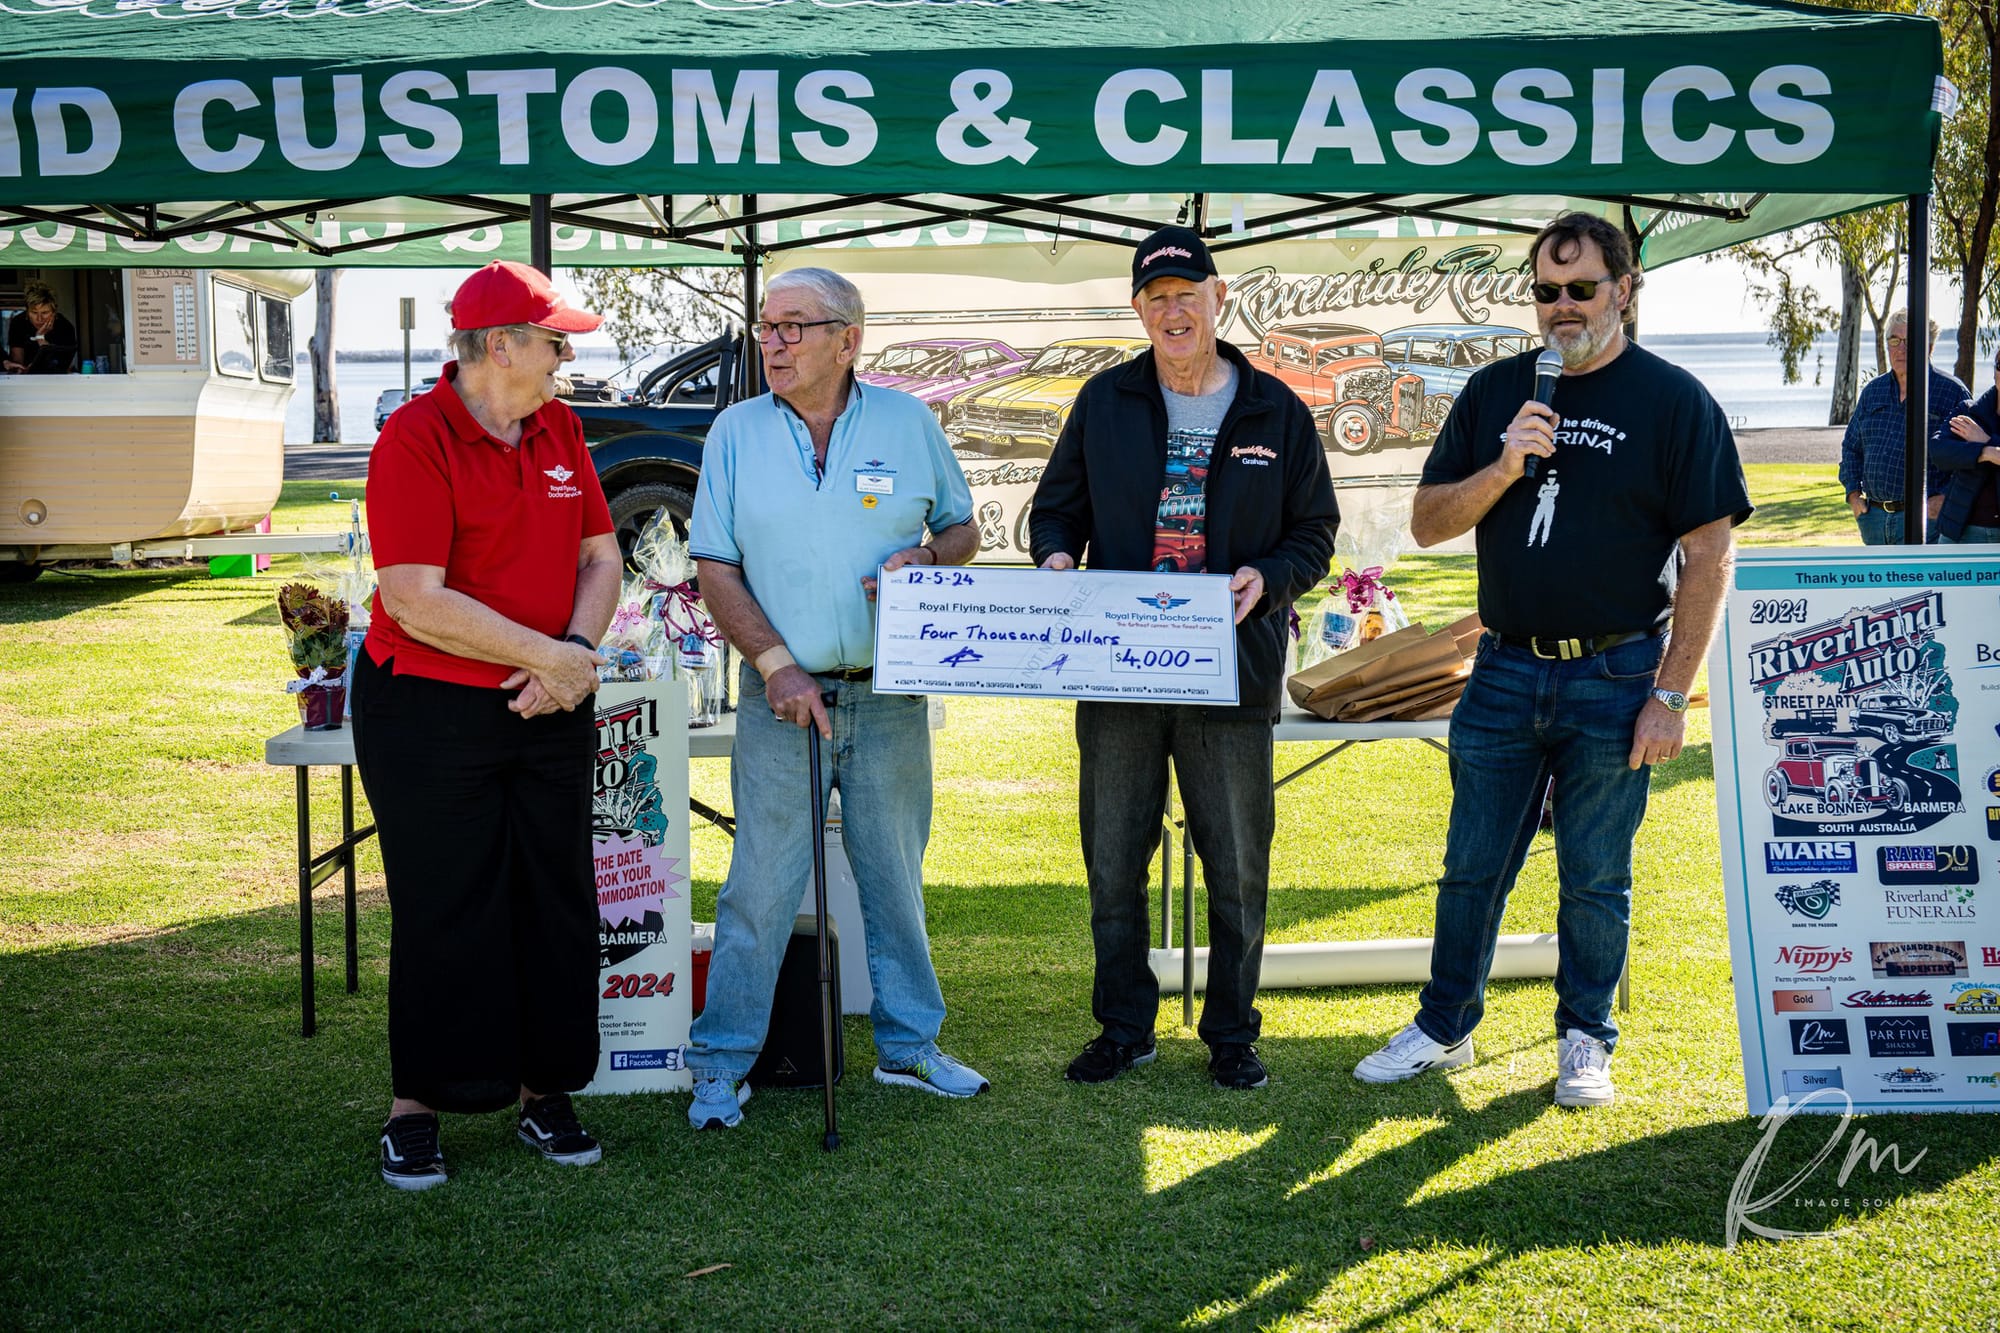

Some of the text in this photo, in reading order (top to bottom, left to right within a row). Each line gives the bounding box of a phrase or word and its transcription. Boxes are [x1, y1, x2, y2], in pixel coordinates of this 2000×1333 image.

[173, 67, 878, 174] CUSTOMS
[936, 68, 1039, 166] &
[1094, 64, 1835, 166] CLASSICS
[1563, 418, 1578, 428] he
[1581, 418, 1616, 435] drives
[1616, 432, 1626, 441] a
[1552, 431, 1612, 454] RINA
[1242, 458, 1269, 466] Graham
[908, 571, 975, 586] 12-5-24
[1795, 570, 2000, 586] Thank you to these valued par
[919, 602, 1070, 615] Royal Flying Doctor Service
[1750, 599, 1807, 624] 2024
[1105, 612, 1224, 624] Royal Flying Doctor Service
[919, 624, 958, 640] Four
[966, 624, 1051, 642] Thousand
[1061, 626, 1120, 645] Dollars
[1749, 592, 1946, 685] Riverland
[1840, 646, 1921, 694] Auto
[1764, 694, 1860, 710] STREET PARTY
[1780, 801, 1966, 814] LAKE BONNEY BARMERA
[1818, 822, 1917, 833] SOUTH AUSTRALIA
[1769, 842, 1852, 860] MARS
[1886, 845, 1969, 872] RARE 50
[595, 848, 642, 872] THE DATE
[1888, 862, 1934, 870] SPARES
[596, 865, 651, 888] OOK YOUR
[596, 879, 665, 906] OMMODATION
[1885, 889, 1948, 902] Riverland
[1886, 905, 1976, 918] FUNERALS
[600, 931, 667, 945] BARMERA
[1774, 945, 1853, 974] Nippy's
[602, 972, 675, 999] 2024
[1792, 995, 1813, 1004] Gold
[623, 1020, 646, 1028] Service
[630, 1030, 644, 1038] 3pm
[1870, 1030, 1929, 1040] PAR FIVE
[629, 1059, 662, 1067] Facebook
[1803, 1076, 1828, 1084] Silver
